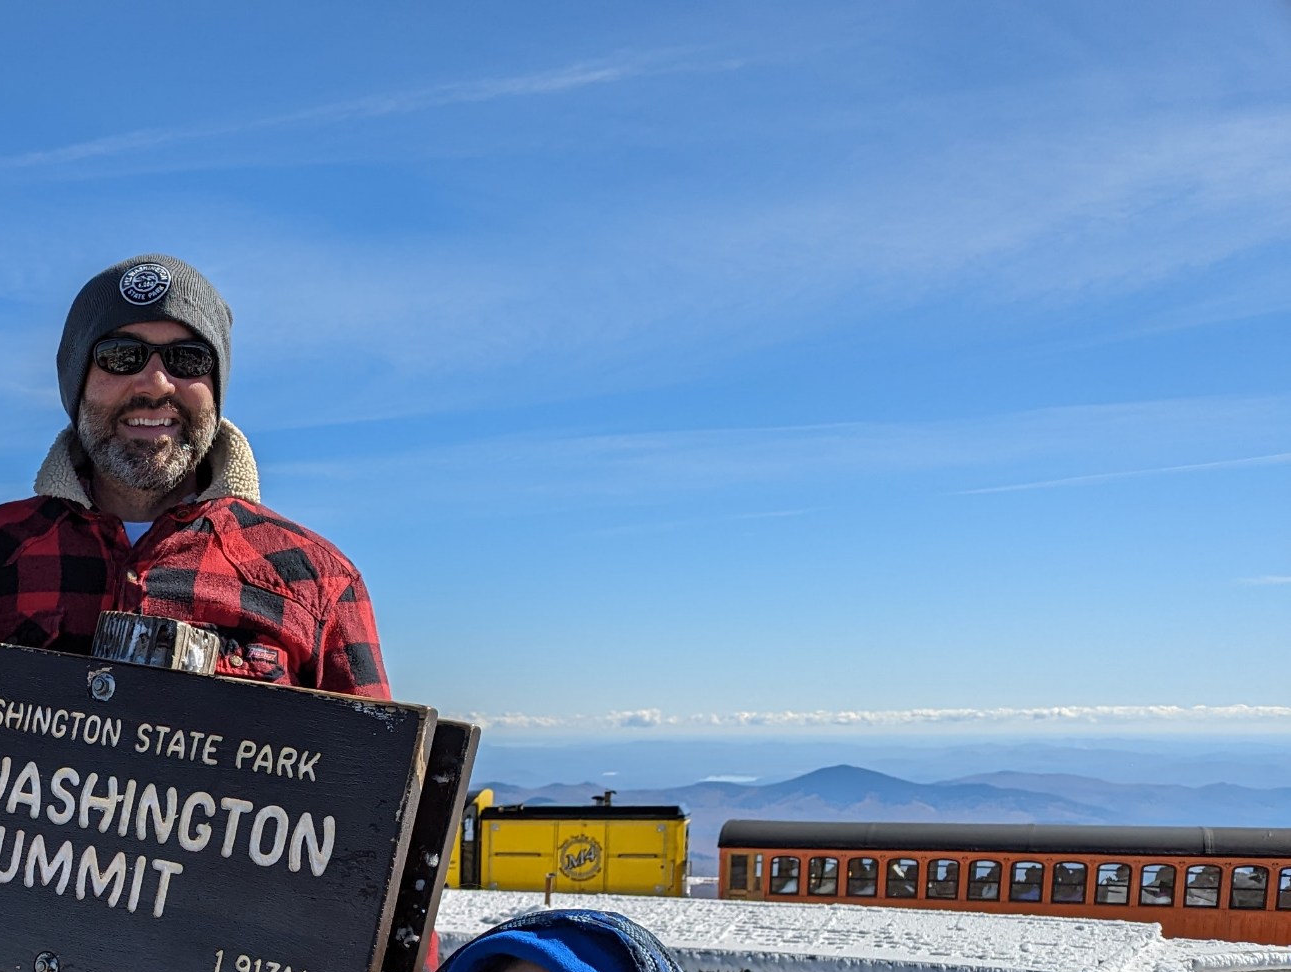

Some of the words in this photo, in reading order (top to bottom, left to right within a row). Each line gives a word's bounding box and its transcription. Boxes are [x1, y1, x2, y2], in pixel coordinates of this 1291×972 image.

[127, 288, 146, 300] STATE
[147, 284, 165, 299] PARK
[135, 722, 224, 766] STATE
[235, 740, 322, 782] PARK
